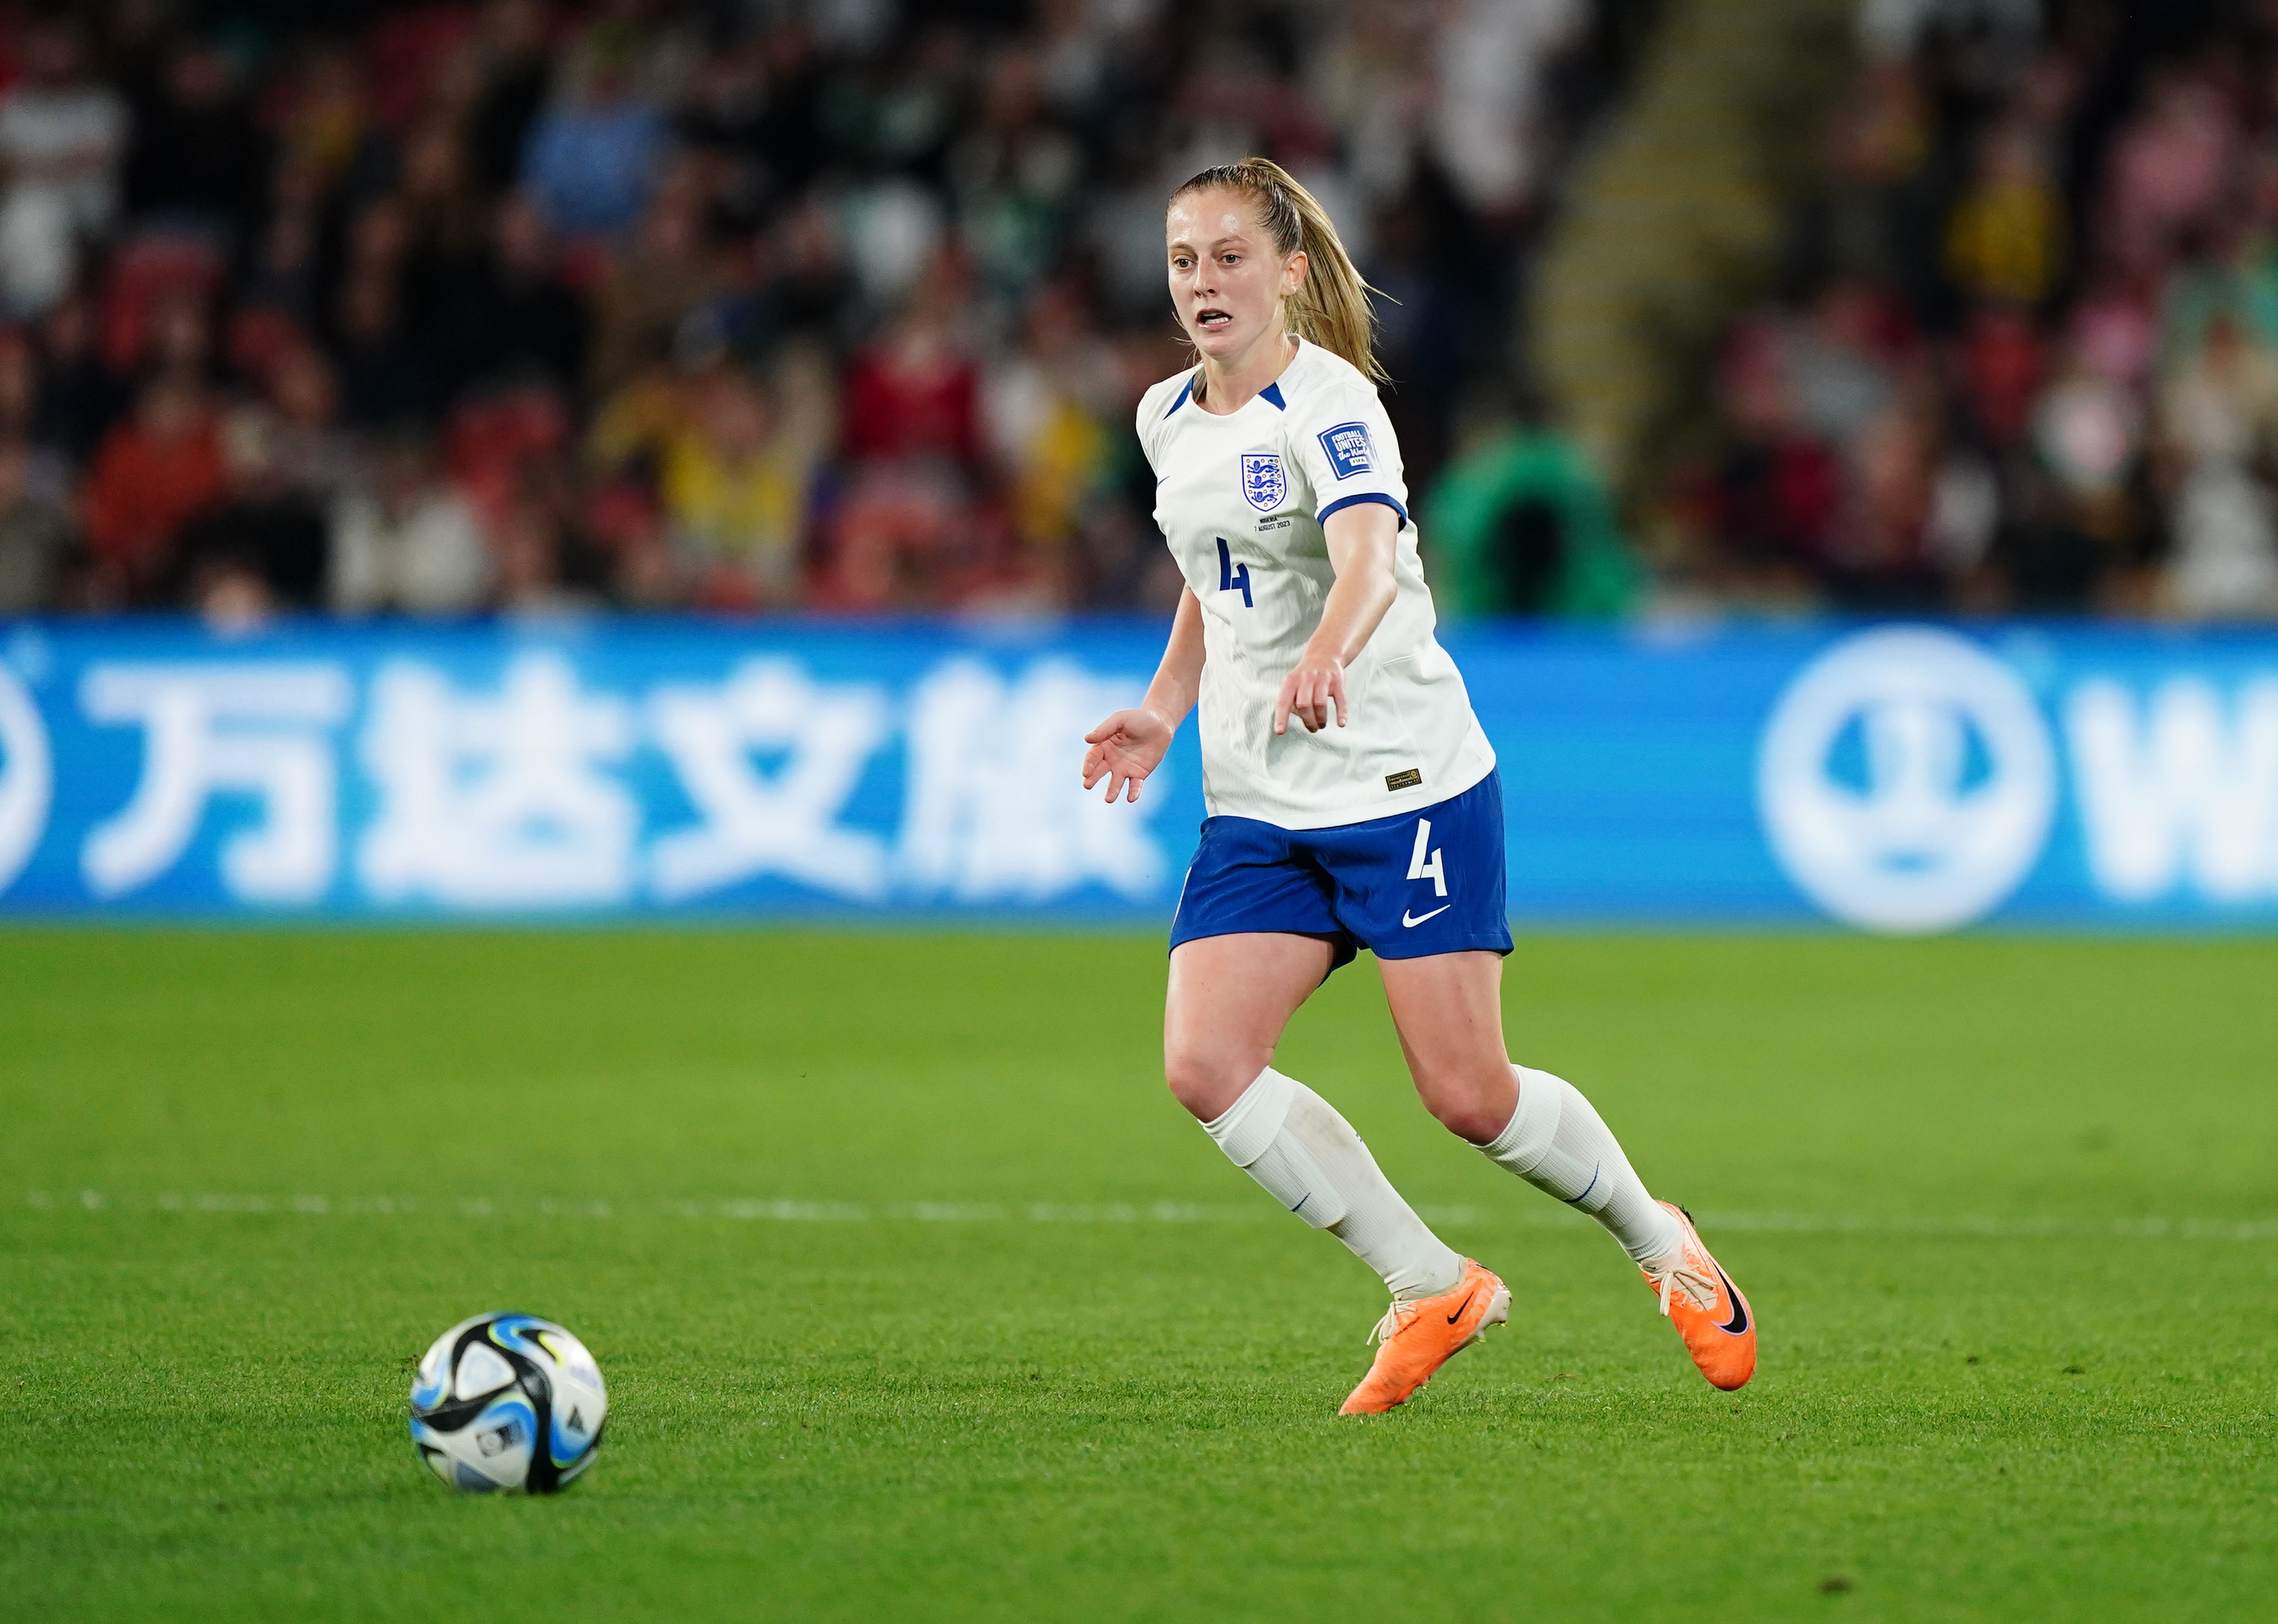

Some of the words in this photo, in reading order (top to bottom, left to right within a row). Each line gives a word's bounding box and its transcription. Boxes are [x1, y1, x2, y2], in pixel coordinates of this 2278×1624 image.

[1331, 430, 1363, 443] FOOTBALL
[1335, 437, 1366, 452] UNITES
[1337, 451, 1351, 461] the
[1258, 523, 1275, 532] AUGUST
[1216, 536, 1254, 608] 4
[1406, 818, 1448, 897] 4
